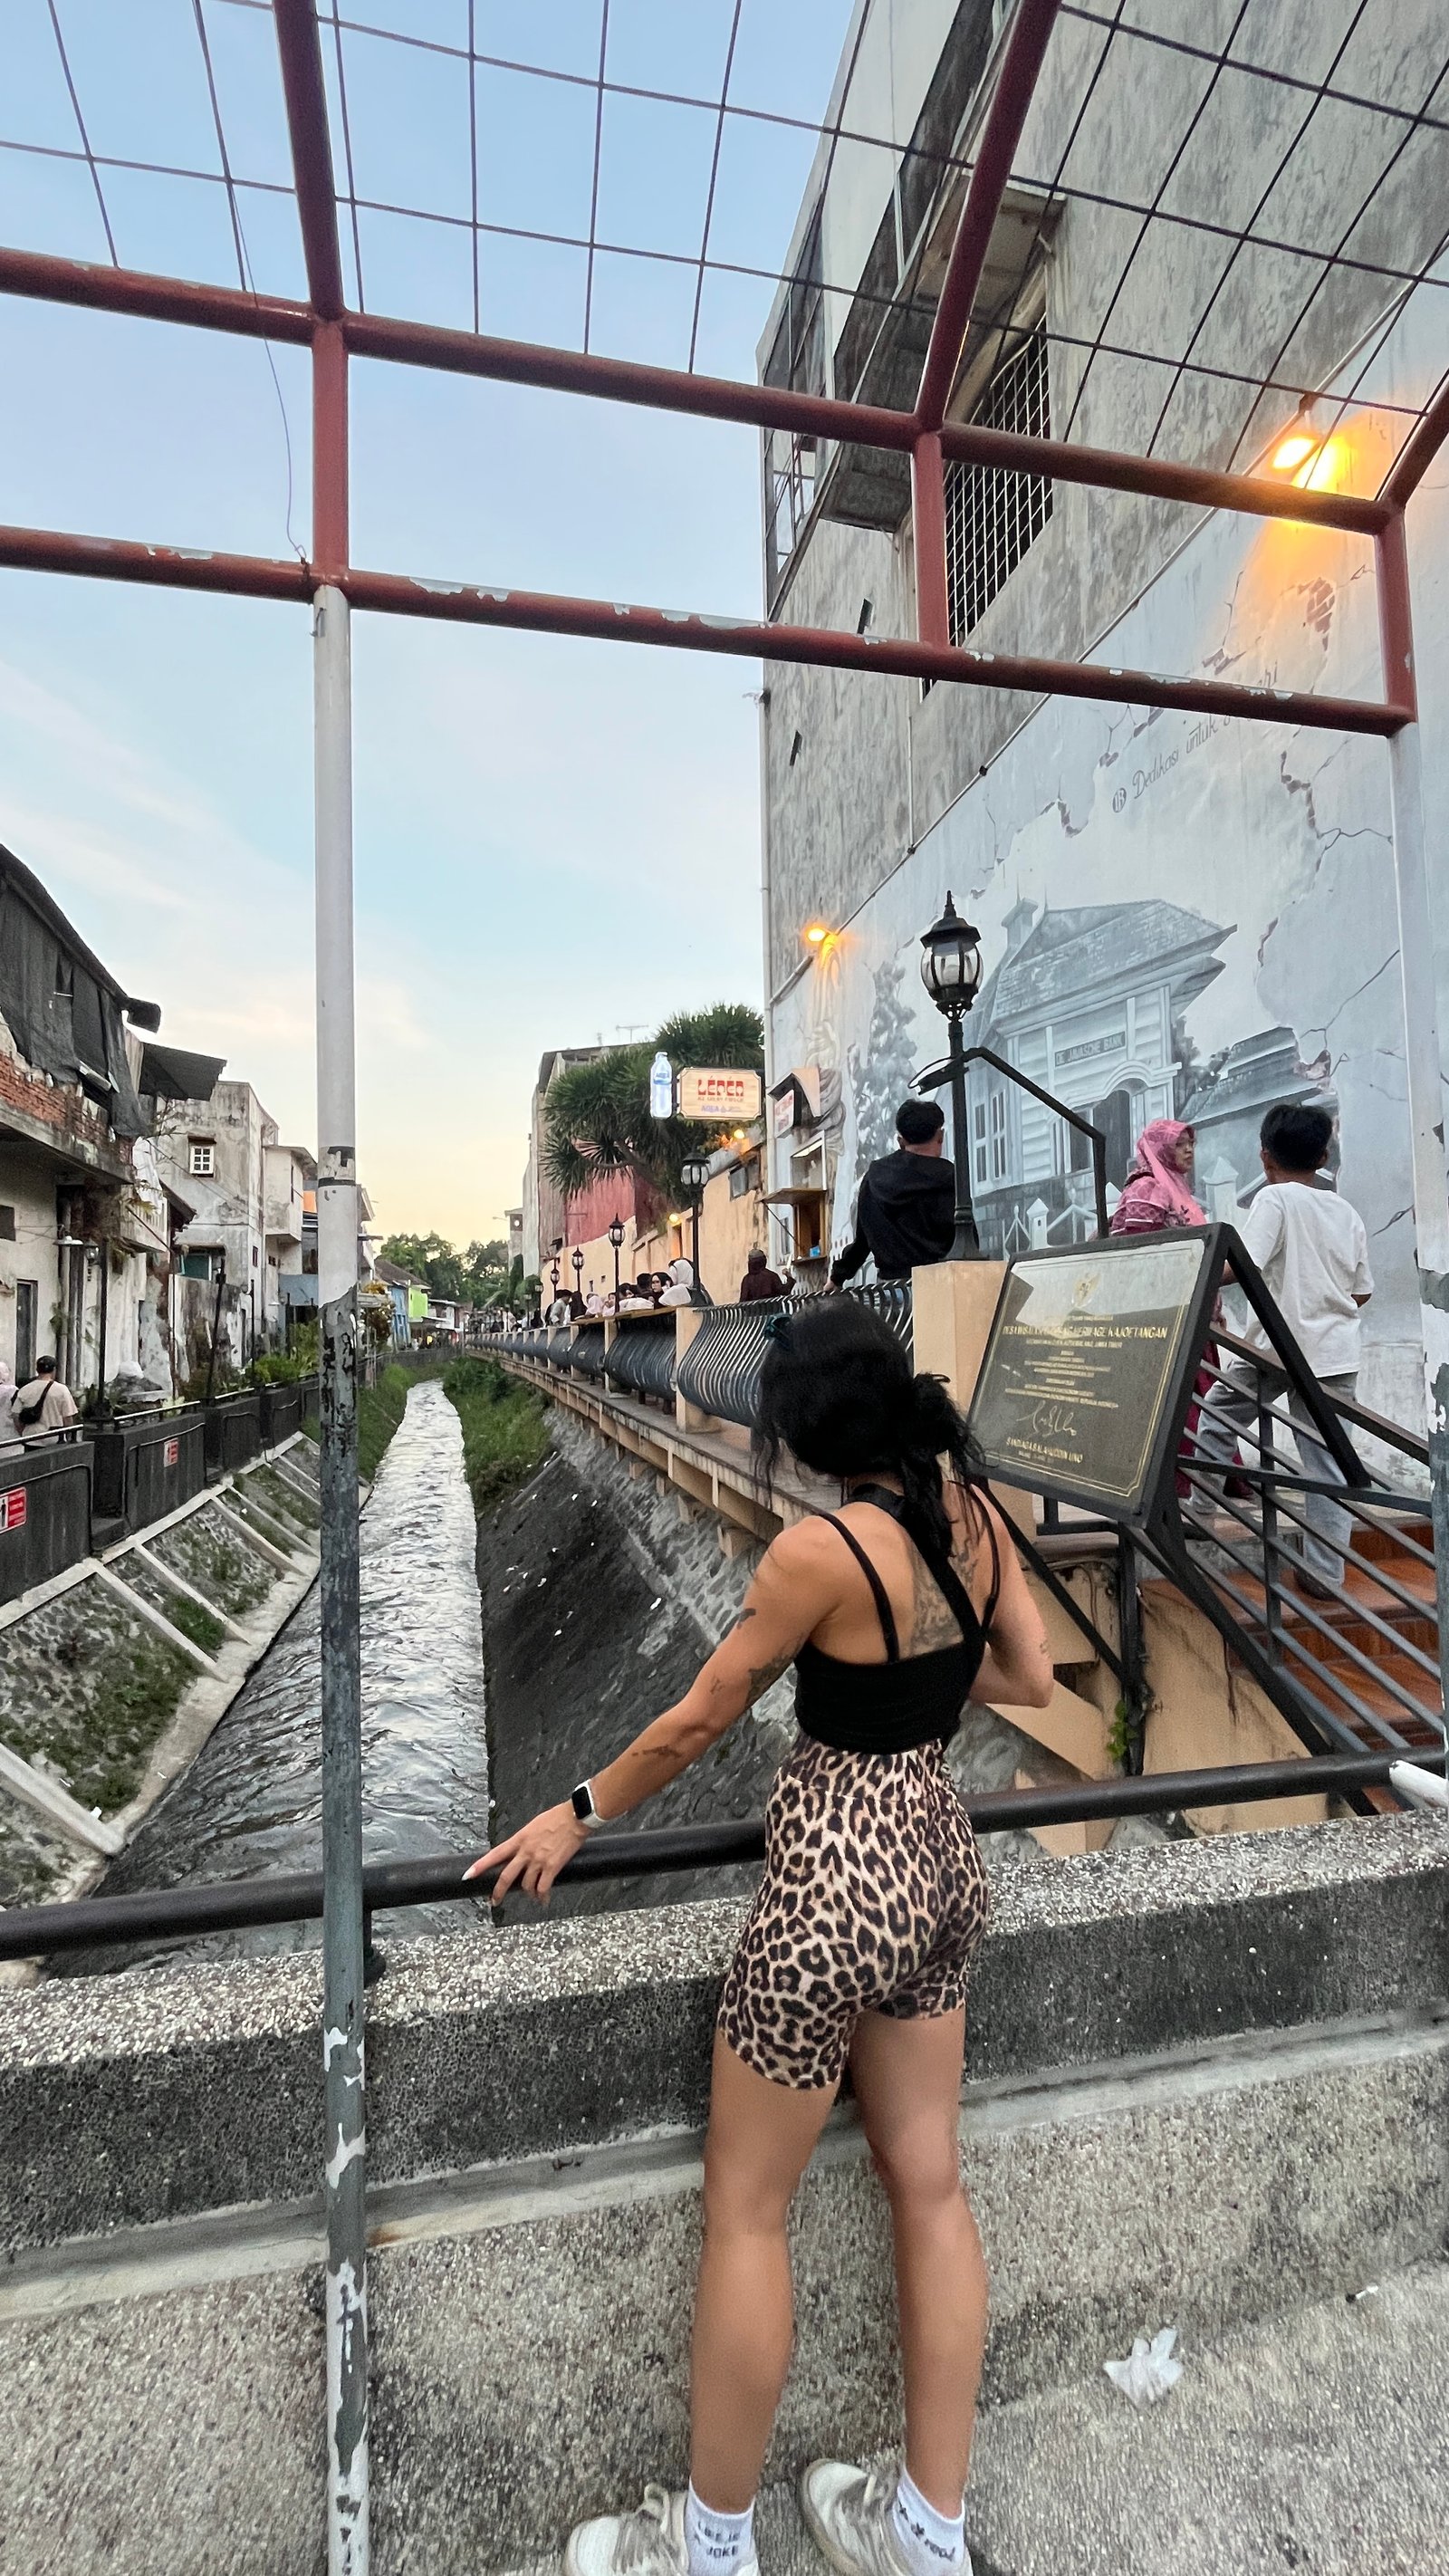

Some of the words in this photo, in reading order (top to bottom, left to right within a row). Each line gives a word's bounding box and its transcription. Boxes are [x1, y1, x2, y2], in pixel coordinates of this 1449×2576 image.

[1132, 747, 1179, 799] Dedikasi
[1185, 714, 1219, 754] untuk
[1103, 1033, 1124, 1051] BANK
[1068, 1453, 1084, 1464] UNO
[706, 2545, 739, 2559] JOKE
